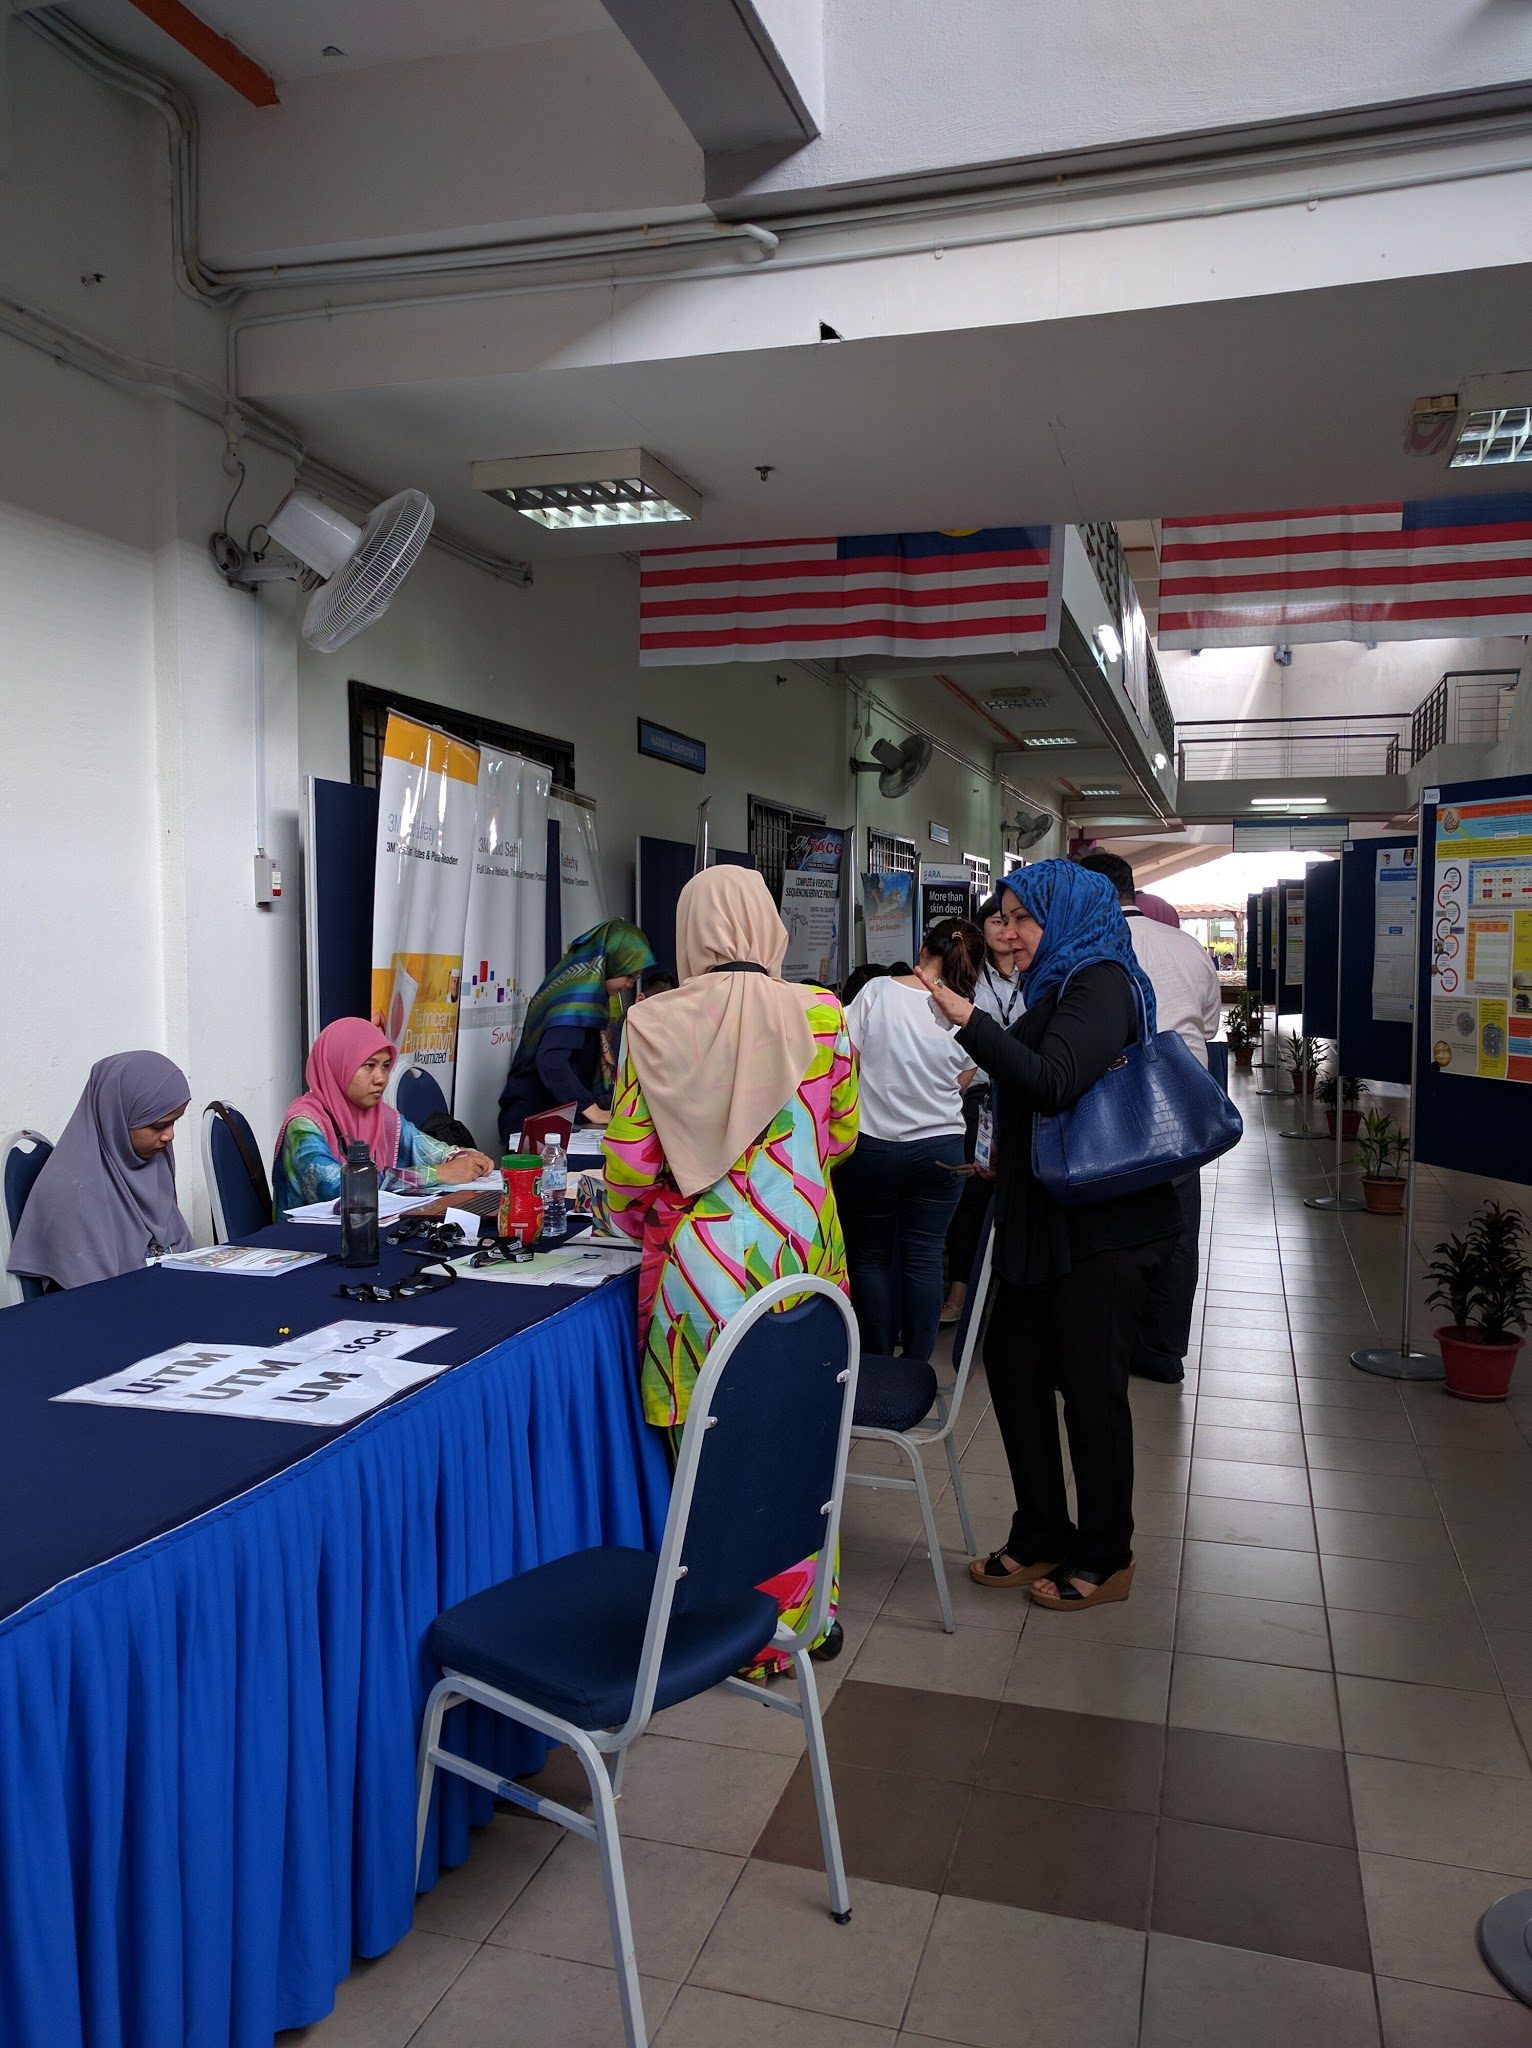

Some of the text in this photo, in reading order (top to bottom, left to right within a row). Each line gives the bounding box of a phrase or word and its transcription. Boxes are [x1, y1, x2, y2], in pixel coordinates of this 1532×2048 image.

[426, 850, 430, 860] &
[929, 890, 964, 902] More than
[930, 902, 963, 916] skin deep
[414, 1049, 448, 1065] Maximized
[110, 1351, 233, 1395] UiTM
[183, 1358, 303, 1401] UTM
[272, 1370, 364, 1403] UM
